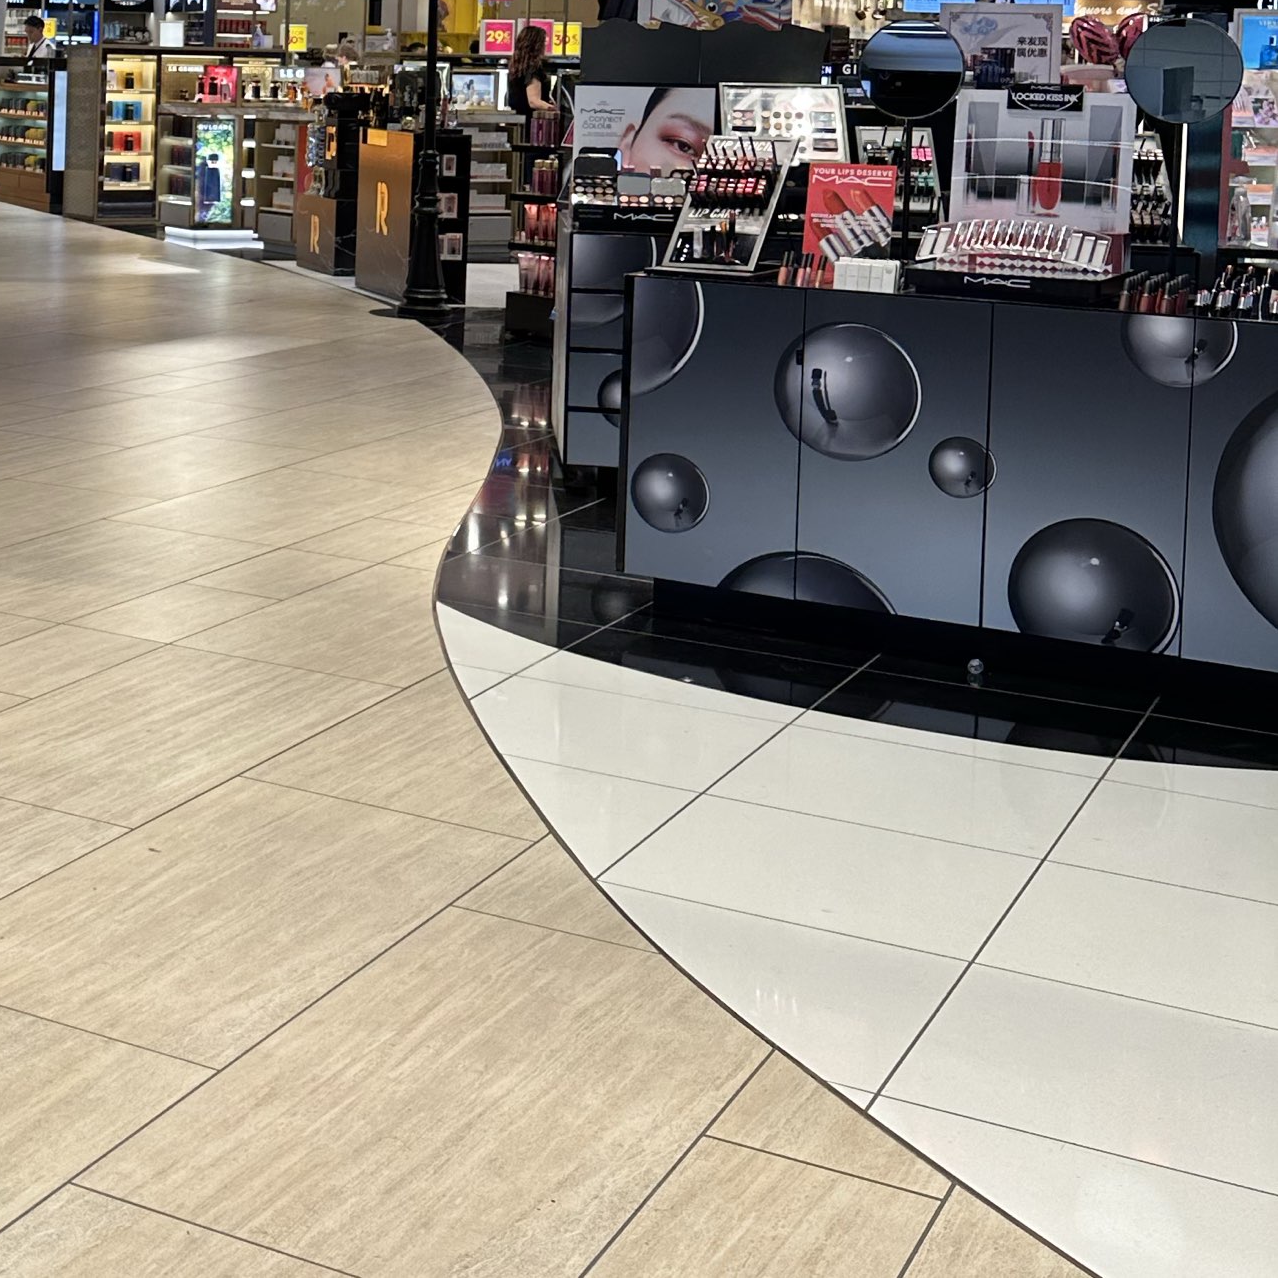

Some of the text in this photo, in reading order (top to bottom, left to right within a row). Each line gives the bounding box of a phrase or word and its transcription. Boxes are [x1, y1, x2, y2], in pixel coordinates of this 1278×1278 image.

[1011, 92, 1079, 102] LOCKED KISS INK
[714, 140, 732, 148] LIP
[813, 167, 894, 177] YOUR LIPS DESERVE
[688, 208, 710, 218] LIP
